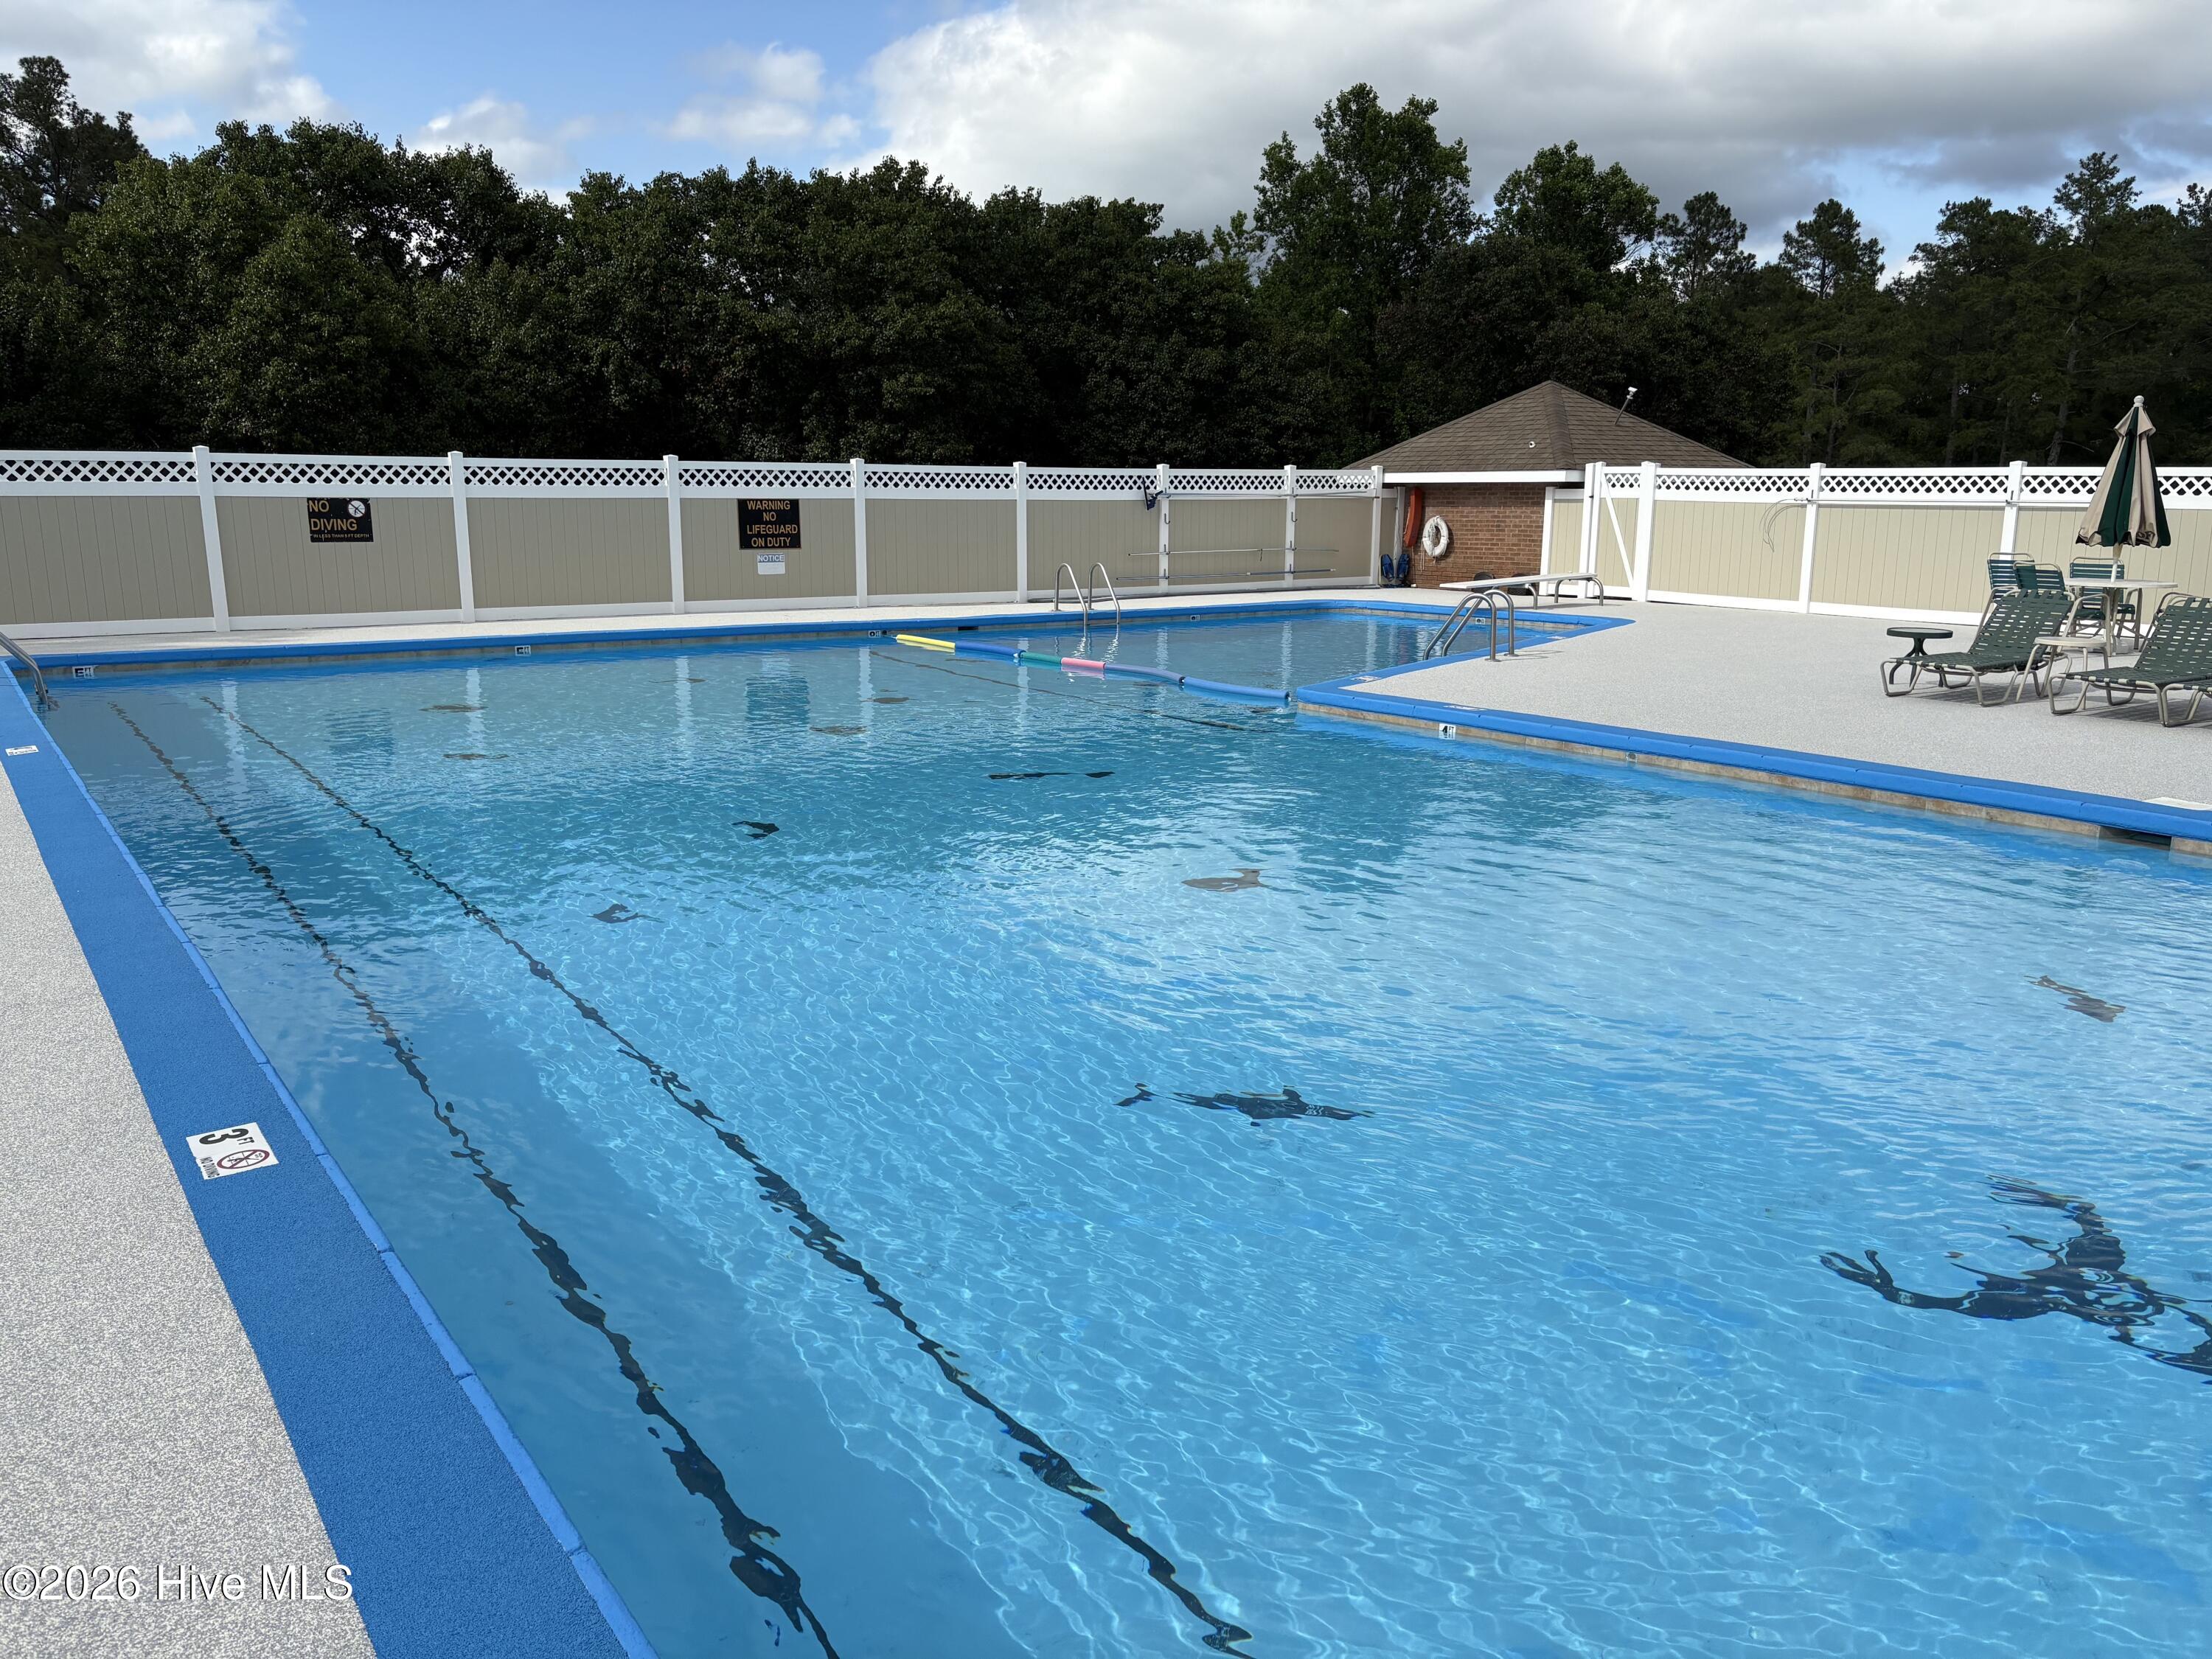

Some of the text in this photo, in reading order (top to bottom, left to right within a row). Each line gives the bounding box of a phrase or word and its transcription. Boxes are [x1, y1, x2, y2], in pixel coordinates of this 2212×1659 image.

[309, 500, 329, 512] NO
[747, 501, 790, 510] WARNING
[763, 512, 776, 521] NO
[310, 518, 358, 531] DIVING
[747, 524, 799, 535] LIFEGUARD
[751, 537, 791, 547] ON DUTY
[198, 1128, 255, 1145] 3 FT
[199, 1156, 220, 1178] NO DIVING
